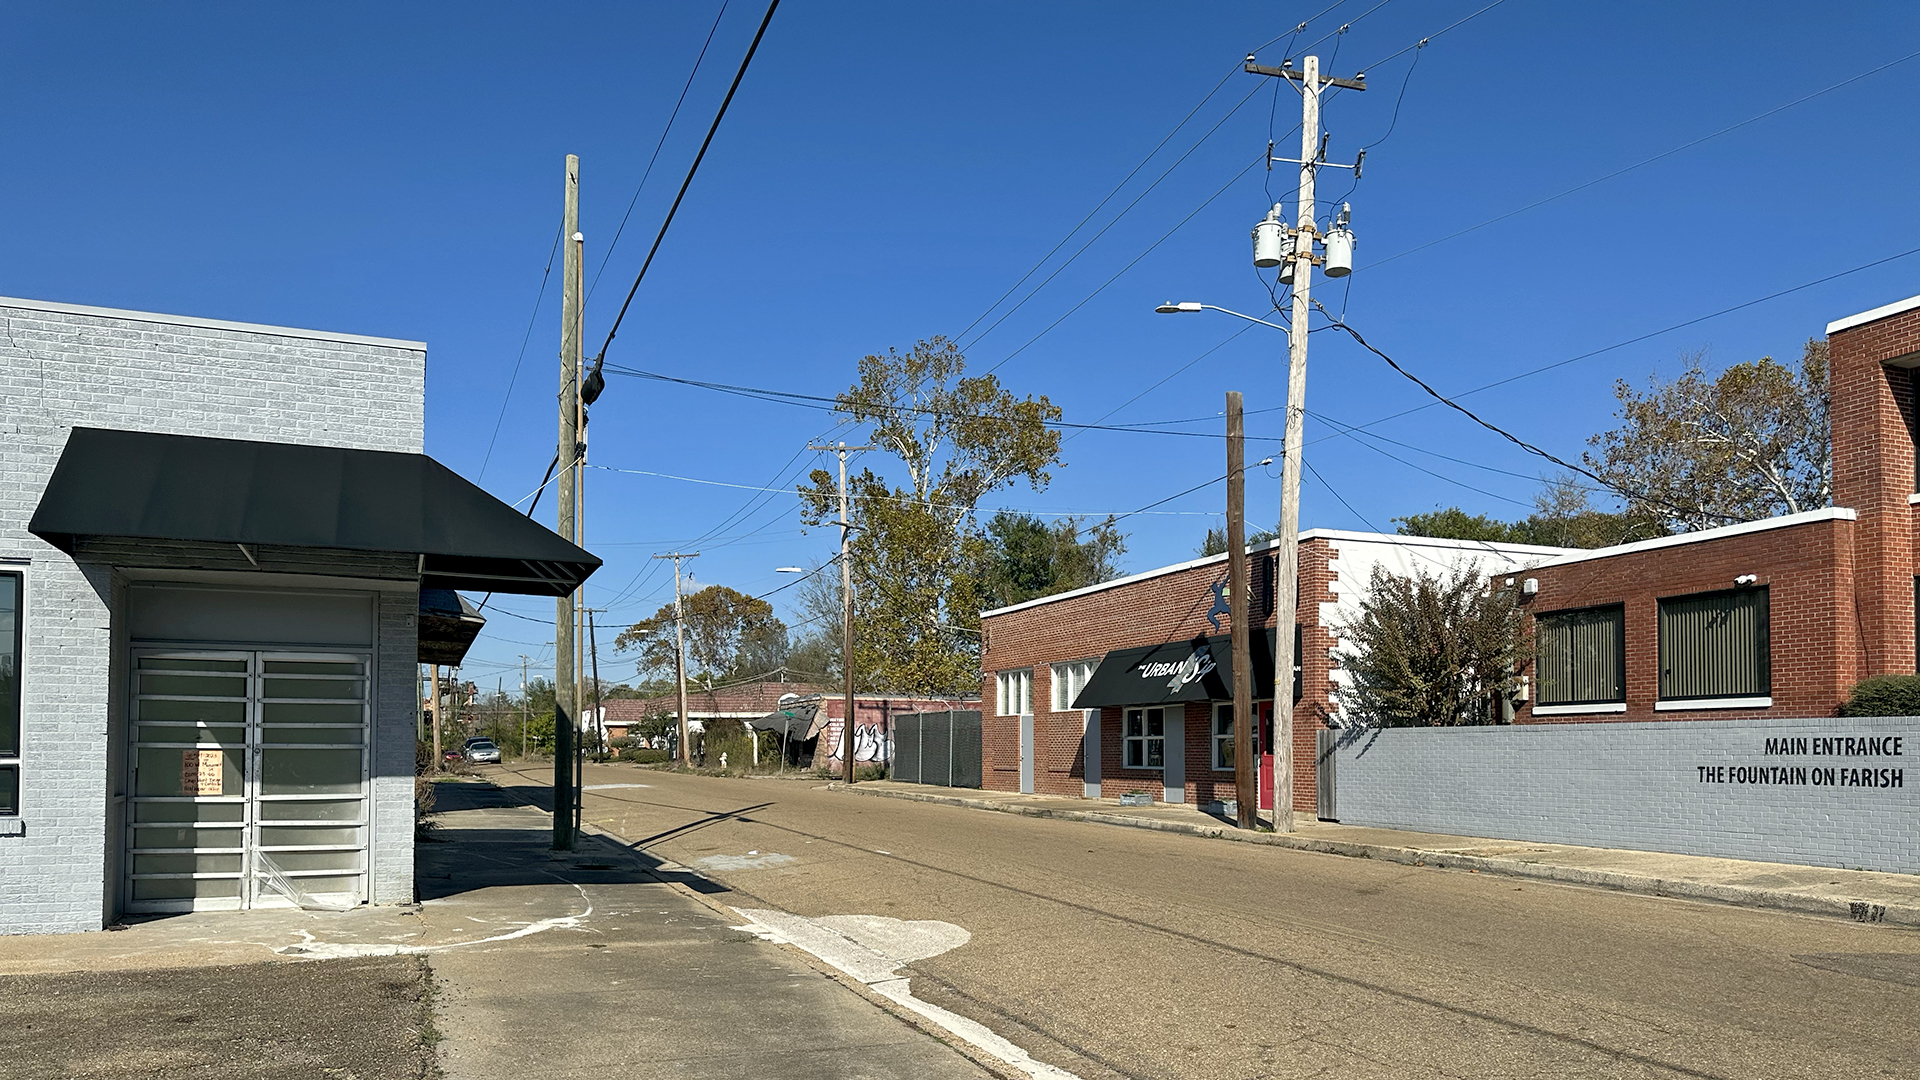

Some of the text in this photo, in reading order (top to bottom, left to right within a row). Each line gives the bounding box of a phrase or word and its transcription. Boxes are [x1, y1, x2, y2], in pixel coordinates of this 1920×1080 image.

[1142, 661, 1189, 678] URBAN
[1764, 736, 1903, 756] MAIN ENTRANCE
[1697, 766, 1903, 788] THE FOUNTAIN ON FARISH
